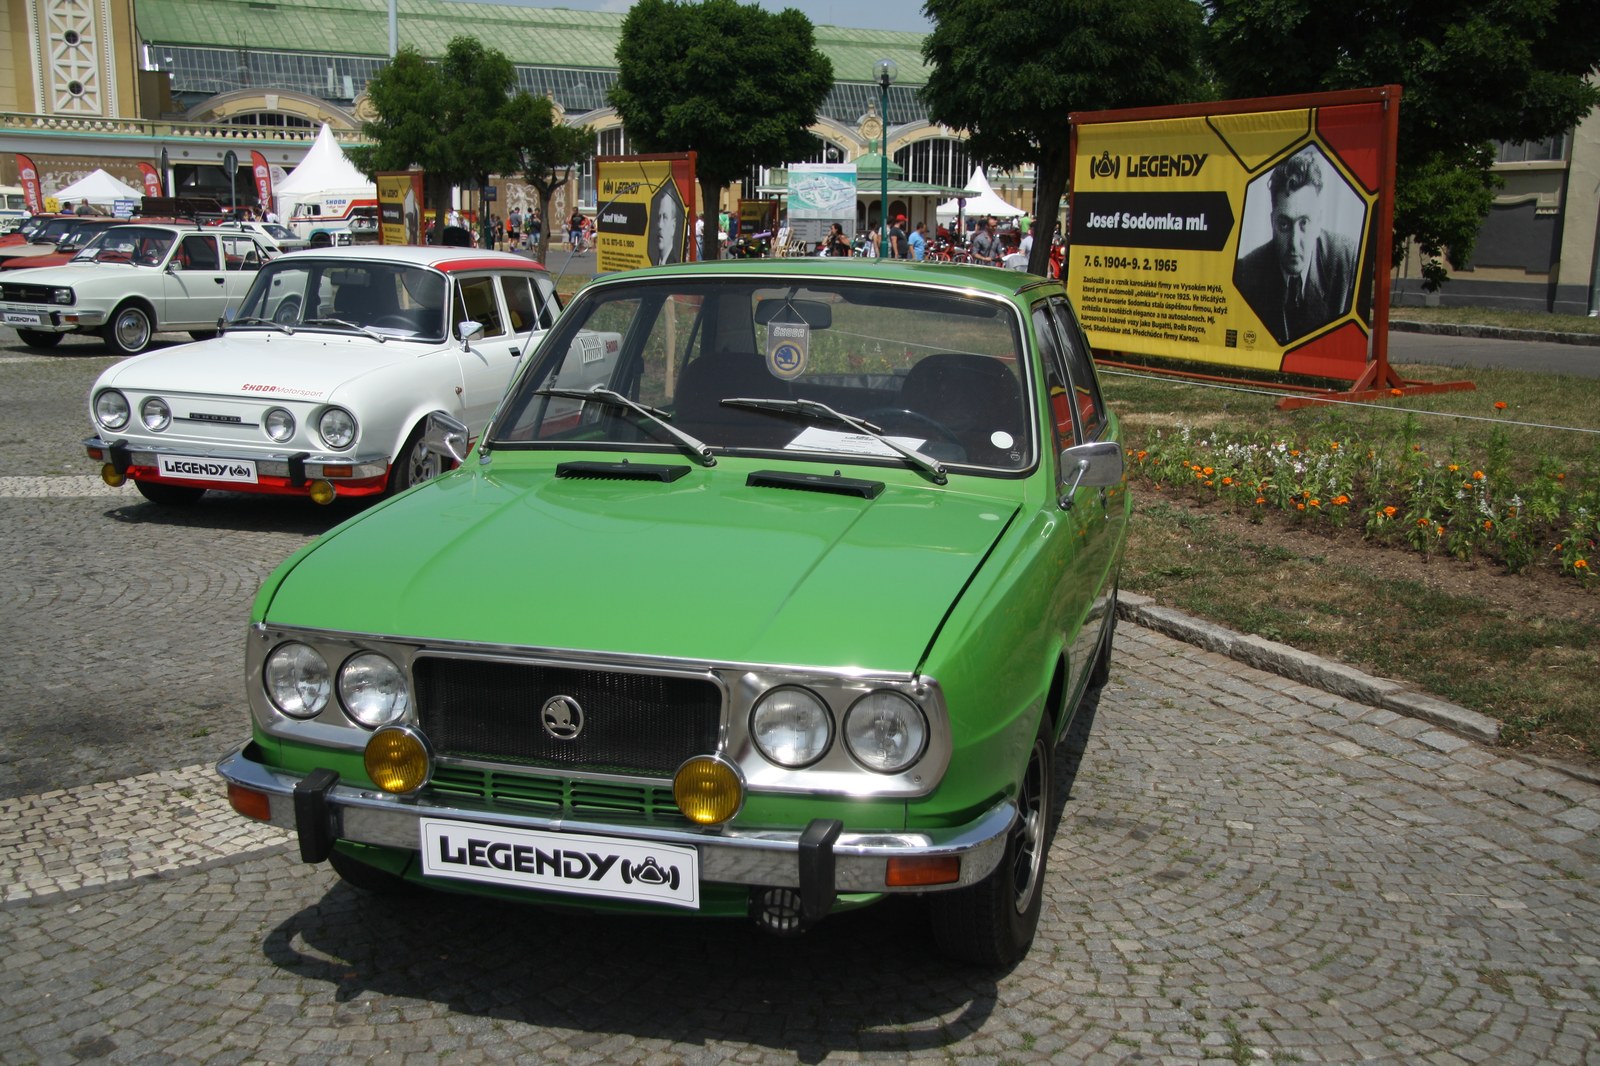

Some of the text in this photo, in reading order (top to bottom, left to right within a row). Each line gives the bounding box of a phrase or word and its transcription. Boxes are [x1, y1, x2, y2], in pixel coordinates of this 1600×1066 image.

[1126, 154, 1208, 178] LEGENDY
[1086, 212, 1208, 231] Josef Sodomka ml.
[1084, 255, 1092, 267] 7.
[1093, 256, 1102, 267] 6.
[1142, 258, 1152, 271] 2.
[1154, 258, 1178, 272] 1965
[1158, 281, 1171, 290] firmy
[1128, 299, 1151, 307] Sodomka
[1188, 325, 1206, 334] Royce,
[1164, 332, 1178, 341] firmy
[1179, 334, 1199, 343] Karosa.
[164, 460, 228, 475] LEGENDY
[440, 835, 621, 881] LEGENDY
